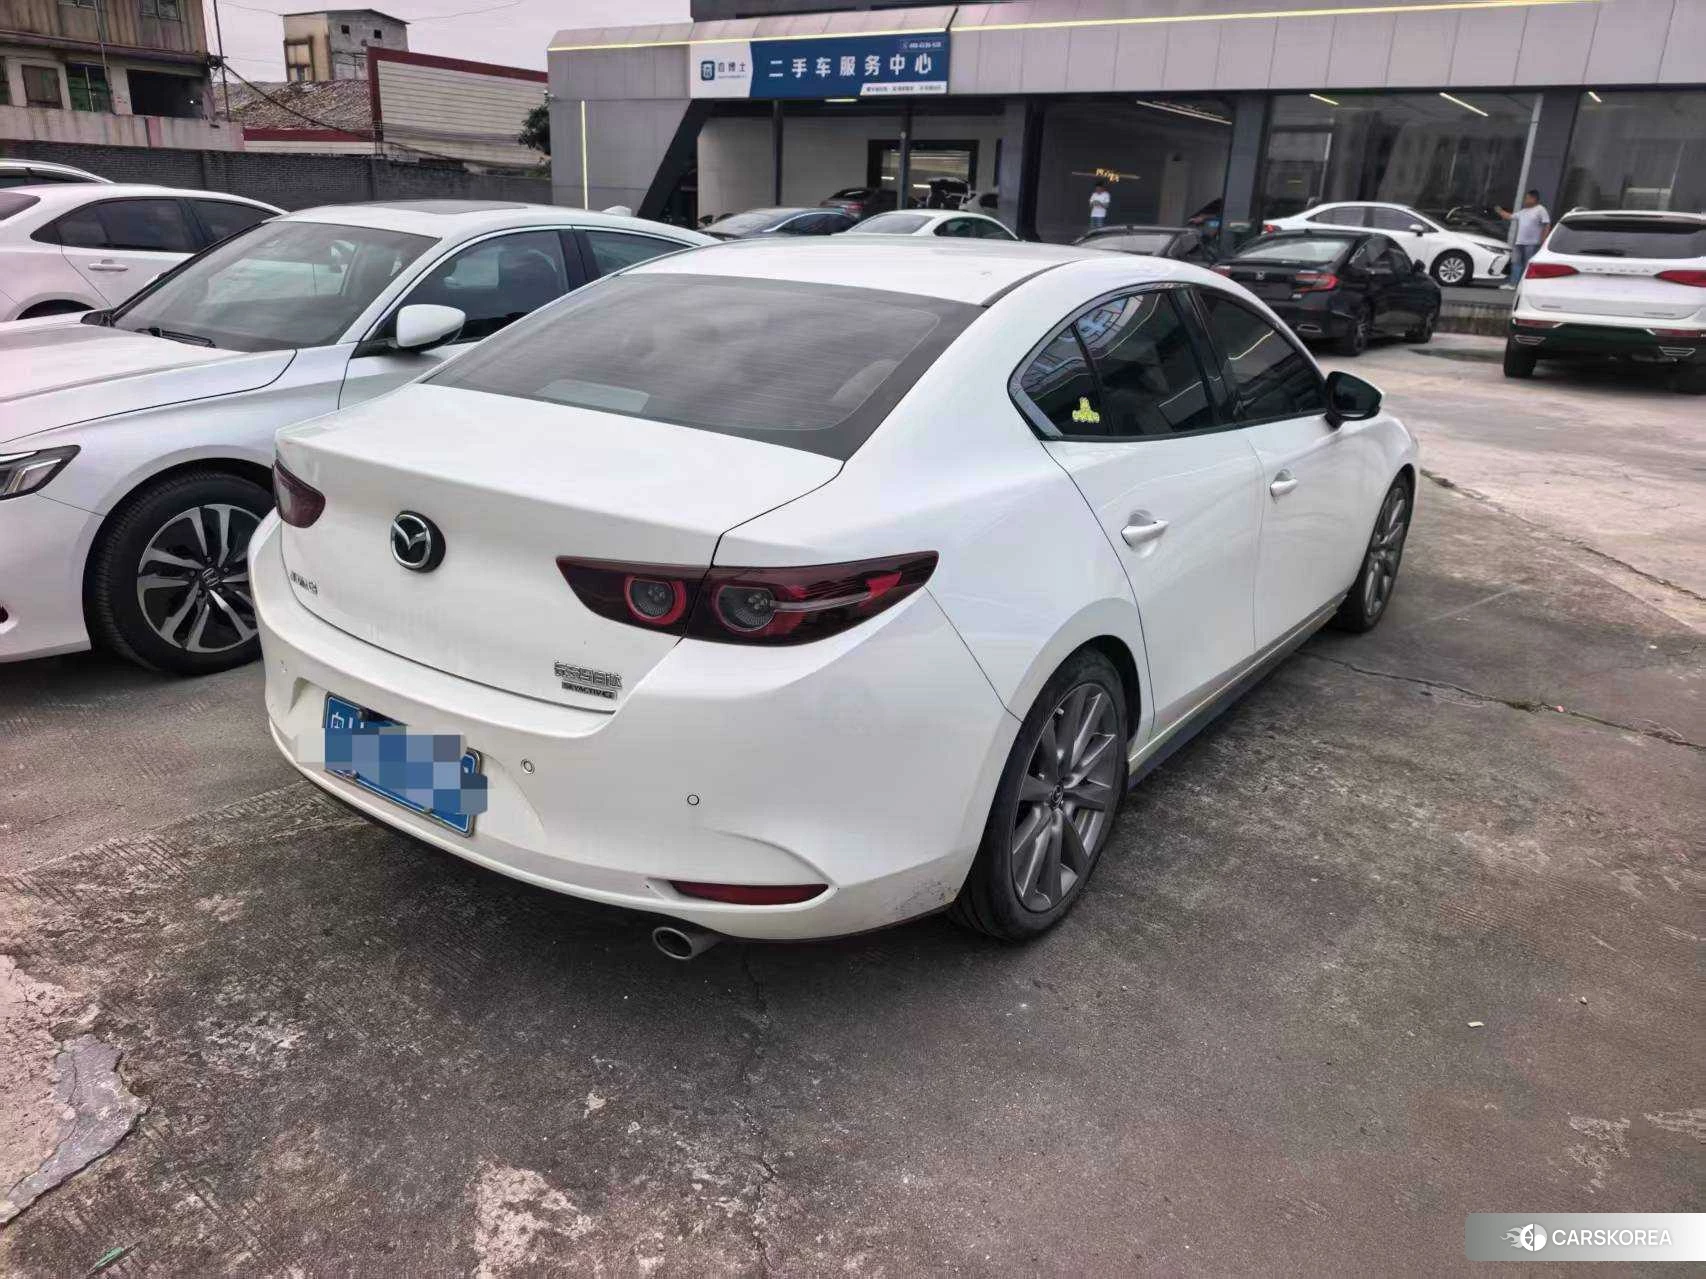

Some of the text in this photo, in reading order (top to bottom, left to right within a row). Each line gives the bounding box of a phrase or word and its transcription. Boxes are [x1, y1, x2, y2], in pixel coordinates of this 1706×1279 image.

[768, 53, 932, 78] 二手车服务中心
